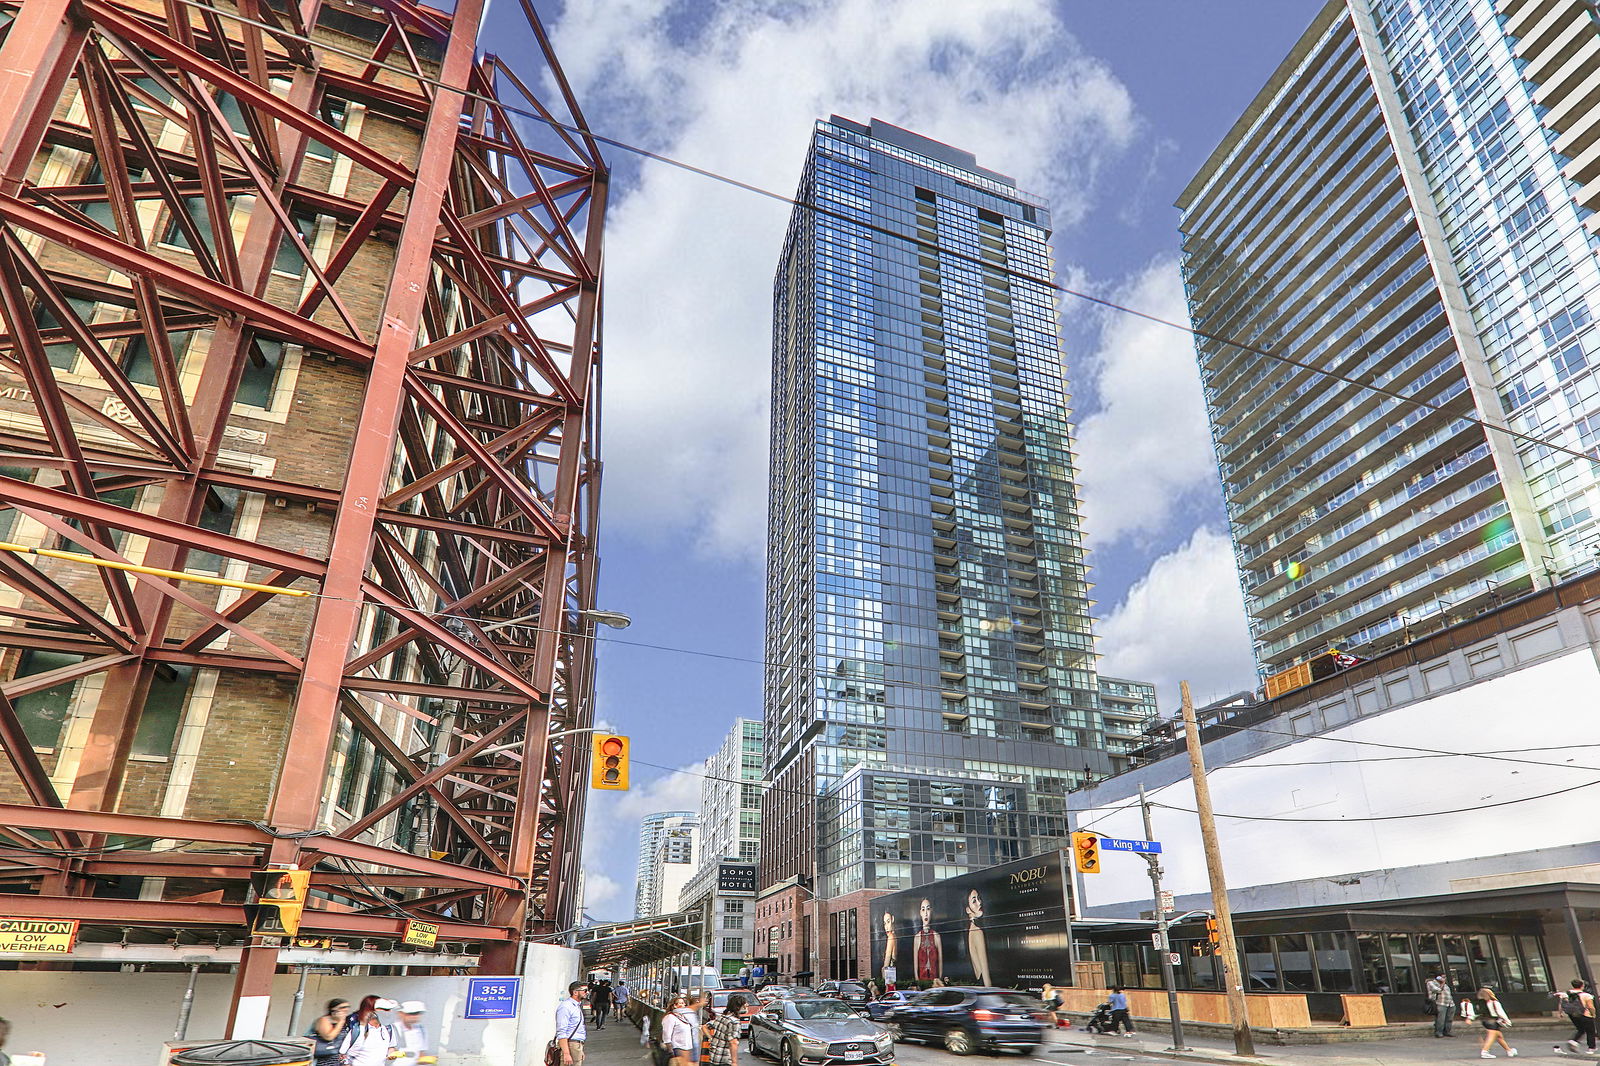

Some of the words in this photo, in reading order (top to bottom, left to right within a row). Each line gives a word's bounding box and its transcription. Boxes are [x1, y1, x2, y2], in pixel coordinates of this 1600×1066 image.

[1113, 840, 1133, 851] King
[1142, 842, 1149, 850] W
[1010, 866, 1047, 884] NOBU
[0, 922, 70, 933] CAUTION
[411, 922, 437, 934] CAUTION
[15, 934, 47, 942] LOW
[407, 937, 433, 946] OVERHEAD
[0, 943, 65, 951] VERHEAD
[482, 986, 506, 994] 355
